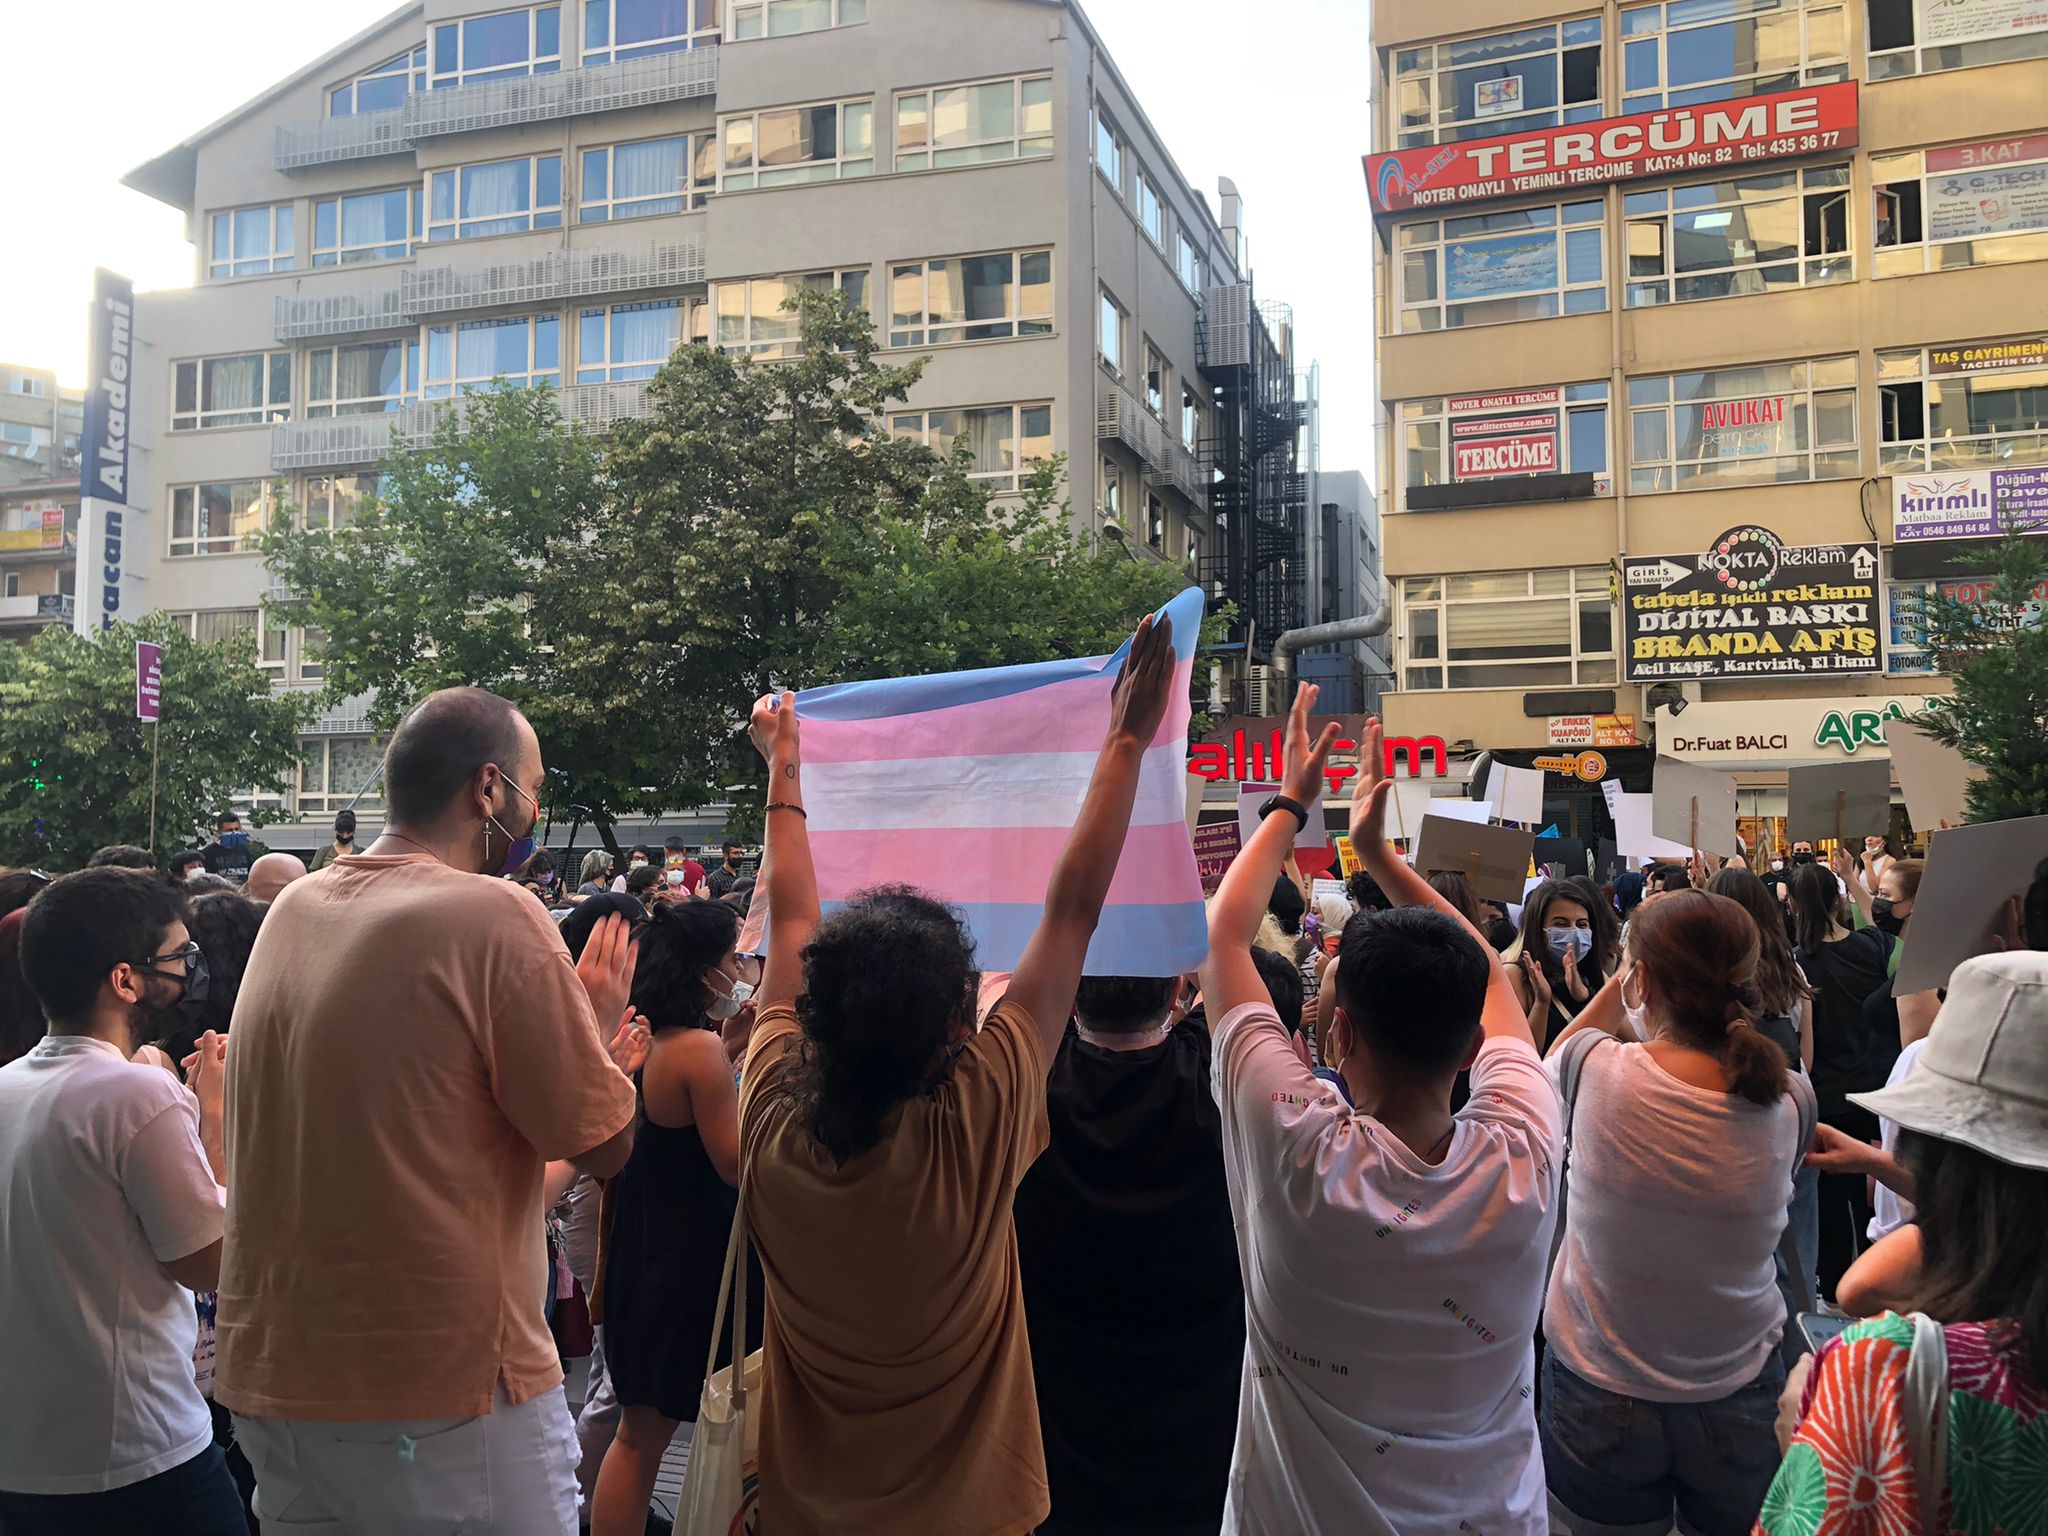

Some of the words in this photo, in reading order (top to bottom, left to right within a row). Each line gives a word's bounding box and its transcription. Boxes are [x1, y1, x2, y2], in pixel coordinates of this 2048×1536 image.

[1466, 97, 1819, 177] TERCÜME
[1960, 141, 2024, 166] 3.KAT
[1413, 187, 1456, 205] NOTER
[1459, 181, 1505, 199] ONAYLI
[1568, 162, 1634, 183] TERCÜME
[1645, 153, 1685, 172] KAT:4
[1688, 151, 1712, 168] No:
[1715, 148, 1733, 162] 82
[1740, 143, 1766, 159] Tel:
[1769, 139, 1796, 154] 435
[1800, 136, 1818, 151] 36
[1822, 131, 1840, 146] 77
[1933, 351, 1960, 366] TAŞ
[1961, 358, 2018, 370] TACETTİN
[2021, 355, 2045, 365] TAŞ
[99, 297, 131, 495] Akademi
[1451, 400, 1480, 410] NOTER
[1481, 397, 1513, 407] ONAYLI
[1514, 391, 1557, 404] TERCÜME
[1702, 396, 1785, 430] AVUKAT
[1456, 417, 1553, 433] www.elittercume.com.tr
[1459, 440, 1552, 473] TERCÜME
[1902, 511, 1942, 523] Matbaa
[1946, 509, 1987, 520] Reklam
[1901, 530, 1922, 538] KAT
[1923, 525, 1945, 537] 0546
[1946, 524, 1964, 535] 849
[1965, 523, 1977, 534] 64
[1978, 522, 1990, 533] 84
[1697, 550, 1769, 571] NOKTA
[1780, 547, 1847, 566] Reklam
[1633, 567, 1669, 577] GİRİŞ
[1643, 576, 1675, 584] TARAFTAN
[1632, 590, 1717, 609] tabela
[1771, 583, 1873, 602] reklam
[1638, 606, 1759, 632] DİJİTAL
[1766, 602, 1869, 626] BASKI
[1632, 630, 1783, 659] BRANDA
[1788, 623, 1877, 656] AFİŞ
[1632, 660, 1665, 676] Acil
[1811, 655, 1829, 669] El
[1562, 717, 1591, 726] ERKEK
[1596, 730, 1612, 738] ALT
[1615, 729, 1633, 737] KAT
[1673, 736, 1732, 751] Dr.Fuat
[1736, 734, 1788, 750] BALCI
